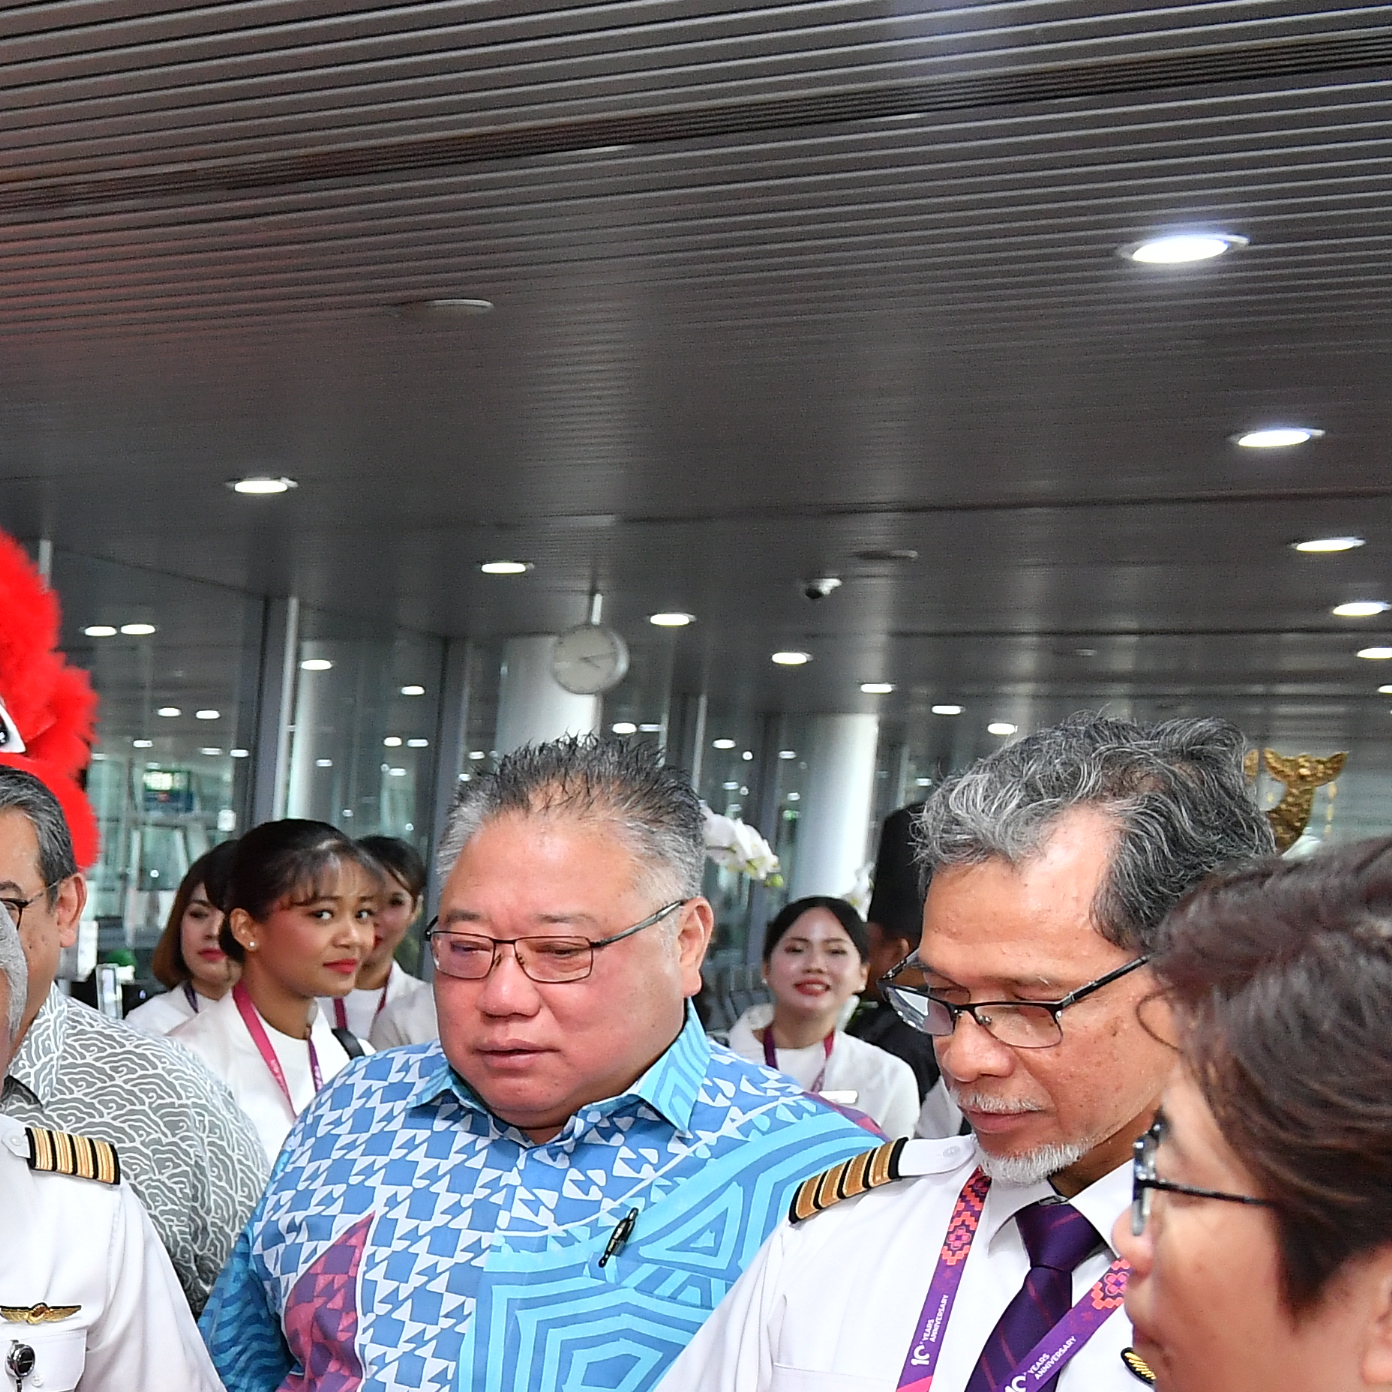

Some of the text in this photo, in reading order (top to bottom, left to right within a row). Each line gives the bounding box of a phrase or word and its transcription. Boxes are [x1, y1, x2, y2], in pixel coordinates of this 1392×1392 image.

[922, 1319, 935, 1342] YEARS
[929, 1294, 949, 1343] ANNIVERSARY
[1027, 1352, 1050, 1375] YEARS
[1034, 1335, 1078, 1381] ANNIVERSARY
